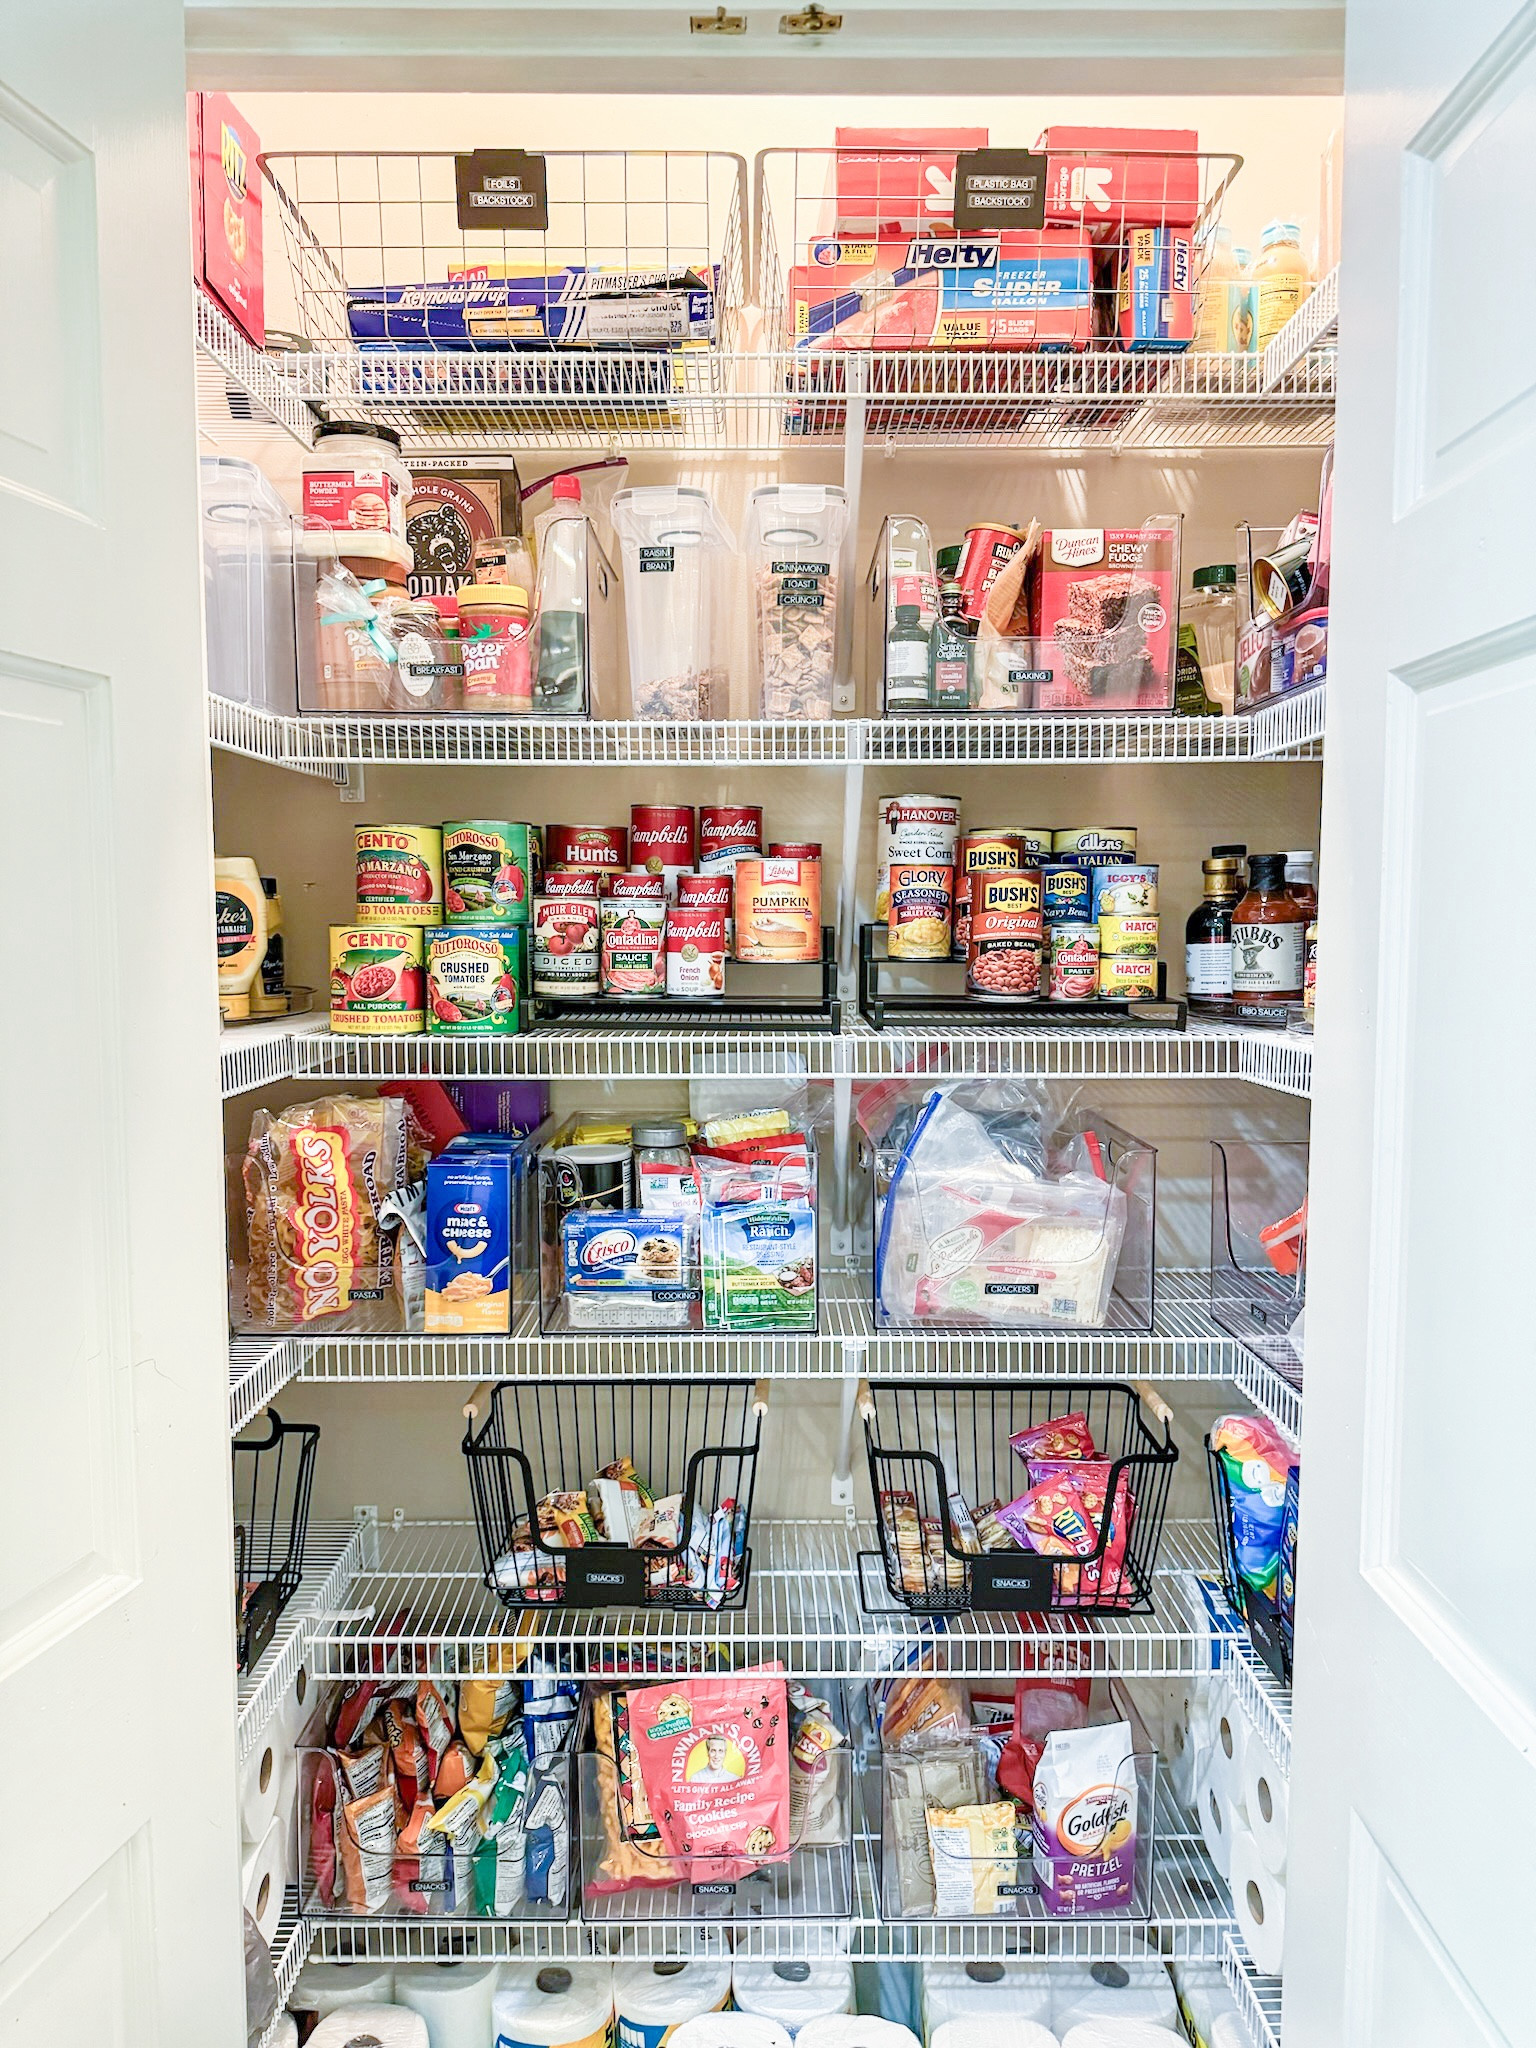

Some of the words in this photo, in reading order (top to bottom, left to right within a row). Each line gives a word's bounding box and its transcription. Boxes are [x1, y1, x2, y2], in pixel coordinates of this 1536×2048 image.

[973, 180, 1009, 189] PLASTIC
[1010, 179, 1029, 189] BAG
[477, 195, 529, 206] BACKSTOCK
[973, 195, 1027, 206] BACKSTOCK
[998, 270, 1047, 280] FREEZER
[398, 285, 466, 306] Reynolds
[466, 281, 509, 306] Wrap
[971, 278, 1062, 298] SLIDER
[992, 296, 1048, 306] GALLON
[943, 322, 982, 333] VALUE
[401, 459, 468, 467] TEIN-PACKED
[308, 480, 353, 489] BUTTERMILK
[308, 487, 339, 496] POWDER
[440, 487, 474, 515] GRAINS
[1148, 532, 1162, 540] SIZE
[1055, 536, 1100, 553] Duncan
[1108, 544, 1148, 553] CHEWY
[643, 548, 669, 558] RAISIN
[1061, 545, 1097, 561] Hines
[1108, 553, 1143, 563] FUDGE
[645, 562, 668, 571] BRAN
[776, 563, 824, 574] CINNAMON
[408, 574, 472, 598] ODIAK
[787, 578, 813, 590] TOAST
[783, 594, 818, 605] CRUNCH
[461, 640, 507, 661] Peter
[937, 643, 966, 654] Simply
[936, 649, 967, 661] Organic
[415, 665, 461, 675] BREAKFAST
[463, 657, 501, 677] Pan
[1015, 671, 1047, 681] BAKING
[901, 809, 956, 822] HANOVER
[702, 817, 759, 840] Campbell's
[358, 834, 409, 850] CENTO
[448, 851, 462, 861] San
[464, 851, 493, 863] Marzano
[726, 846, 755, 856] COOKING
[888, 845, 921, 858] Sweet
[925, 845, 952, 858] Corn
[969, 851, 1016, 868] BUSH'S
[1077, 855, 1122, 866] ITALIAN
[366, 861, 422, 880] MARZANO
[768, 865, 795, 878] Libby's
[899, 870, 946, 887] GLORY
[1048, 877, 1086, 892] BUSH'S
[1107, 874, 1147, 883] IGGY'S
[545, 877, 594, 897] Campbell's
[613, 878, 662, 899] Campbell's
[895, 888, 949, 904] SEASONED
[989, 887, 1037, 904] BUSH'S
[752, 897, 810, 907] PUMPKIN
[373, 905, 432, 916] TOMATOES
[542, 904, 567, 917] MUIR
[570, 904, 594, 918] GLEN
[924, 909, 943, 919] CORN
[1042, 908, 1065, 918] Navy
[1067, 907, 1088, 917] Beans
[985, 915, 1040, 930] Original
[1125, 922, 1157, 932] HATCH
[667, 920, 721, 941] Campbell's
[347, 933, 407, 949] CENTO
[607, 932, 658, 948] Contadina
[986, 941, 1012, 949] BAKED
[1014, 941, 1036, 949] BEANS
[434, 939, 498, 955] TUTTOROSSO
[543, 957, 593, 966] DICED
[616, 953, 649, 961] SAUCE
[440, 961, 489, 974] CRUSHED
[1116, 964, 1151, 974] HATCH
[444, 975, 485, 984] TOMATOES
[680, 973, 700, 982] Onion
[369, 1003, 402, 1011] PURPOSE
[1241, 1007, 1257, 1016] BBQ
[333, 1014, 370, 1024] CRUSHED
[373, 1014, 423, 1024] TOMATOES
[362, 1150, 382, 1221] BROAD
[302, 1137, 341, 1257] YOLKS
[340, 1189, 349, 1218] PASTA
[446, 1215, 476, 1228] mac
[477, 1215, 489, 1228] &
[342, 1219, 350, 1246] WHITE
[442, 1227, 492, 1239] cheese
[750, 1224, 791, 1238] Ranch
[587, 1240, 629, 1265] Crisco
[266, 1252, 277, 1274] Free
[990, 1285, 1032, 1294] CRACKERS
[352, 1292, 378, 1300] PASTA
[657, 1292, 697, 1300] COOKING
[884, 1495, 911, 1504] RITZ
[1053, 1504, 1083, 1542] RITZ
[590, 1573, 621, 1583] SNACKS
[994, 1580, 1028, 1588] SNACKS
[671, 1721, 741, 1783] NEWMAN'S
[739, 1735, 761, 1777] OWN
[691, 1785, 709, 1795] GIVE
[711, 1784, 718, 1793] IT
[719, 1783, 734, 1793] ALL
[673, 1798, 713, 1813] Family
[714, 1790, 756, 1807] Recipe
[688, 1807, 739, 1826] Cookies
[1067, 1799, 1129, 1837] Goldfish
[731, 1820, 749, 1832] CHIP
[1070, 1855, 1123, 1878] PRETZEL
[414, 1883, 446, 1892] SNACKS
[698, 1885, 730, 1894] SNACKS
[1001, 1886, 1034, 1894] SNACKS
